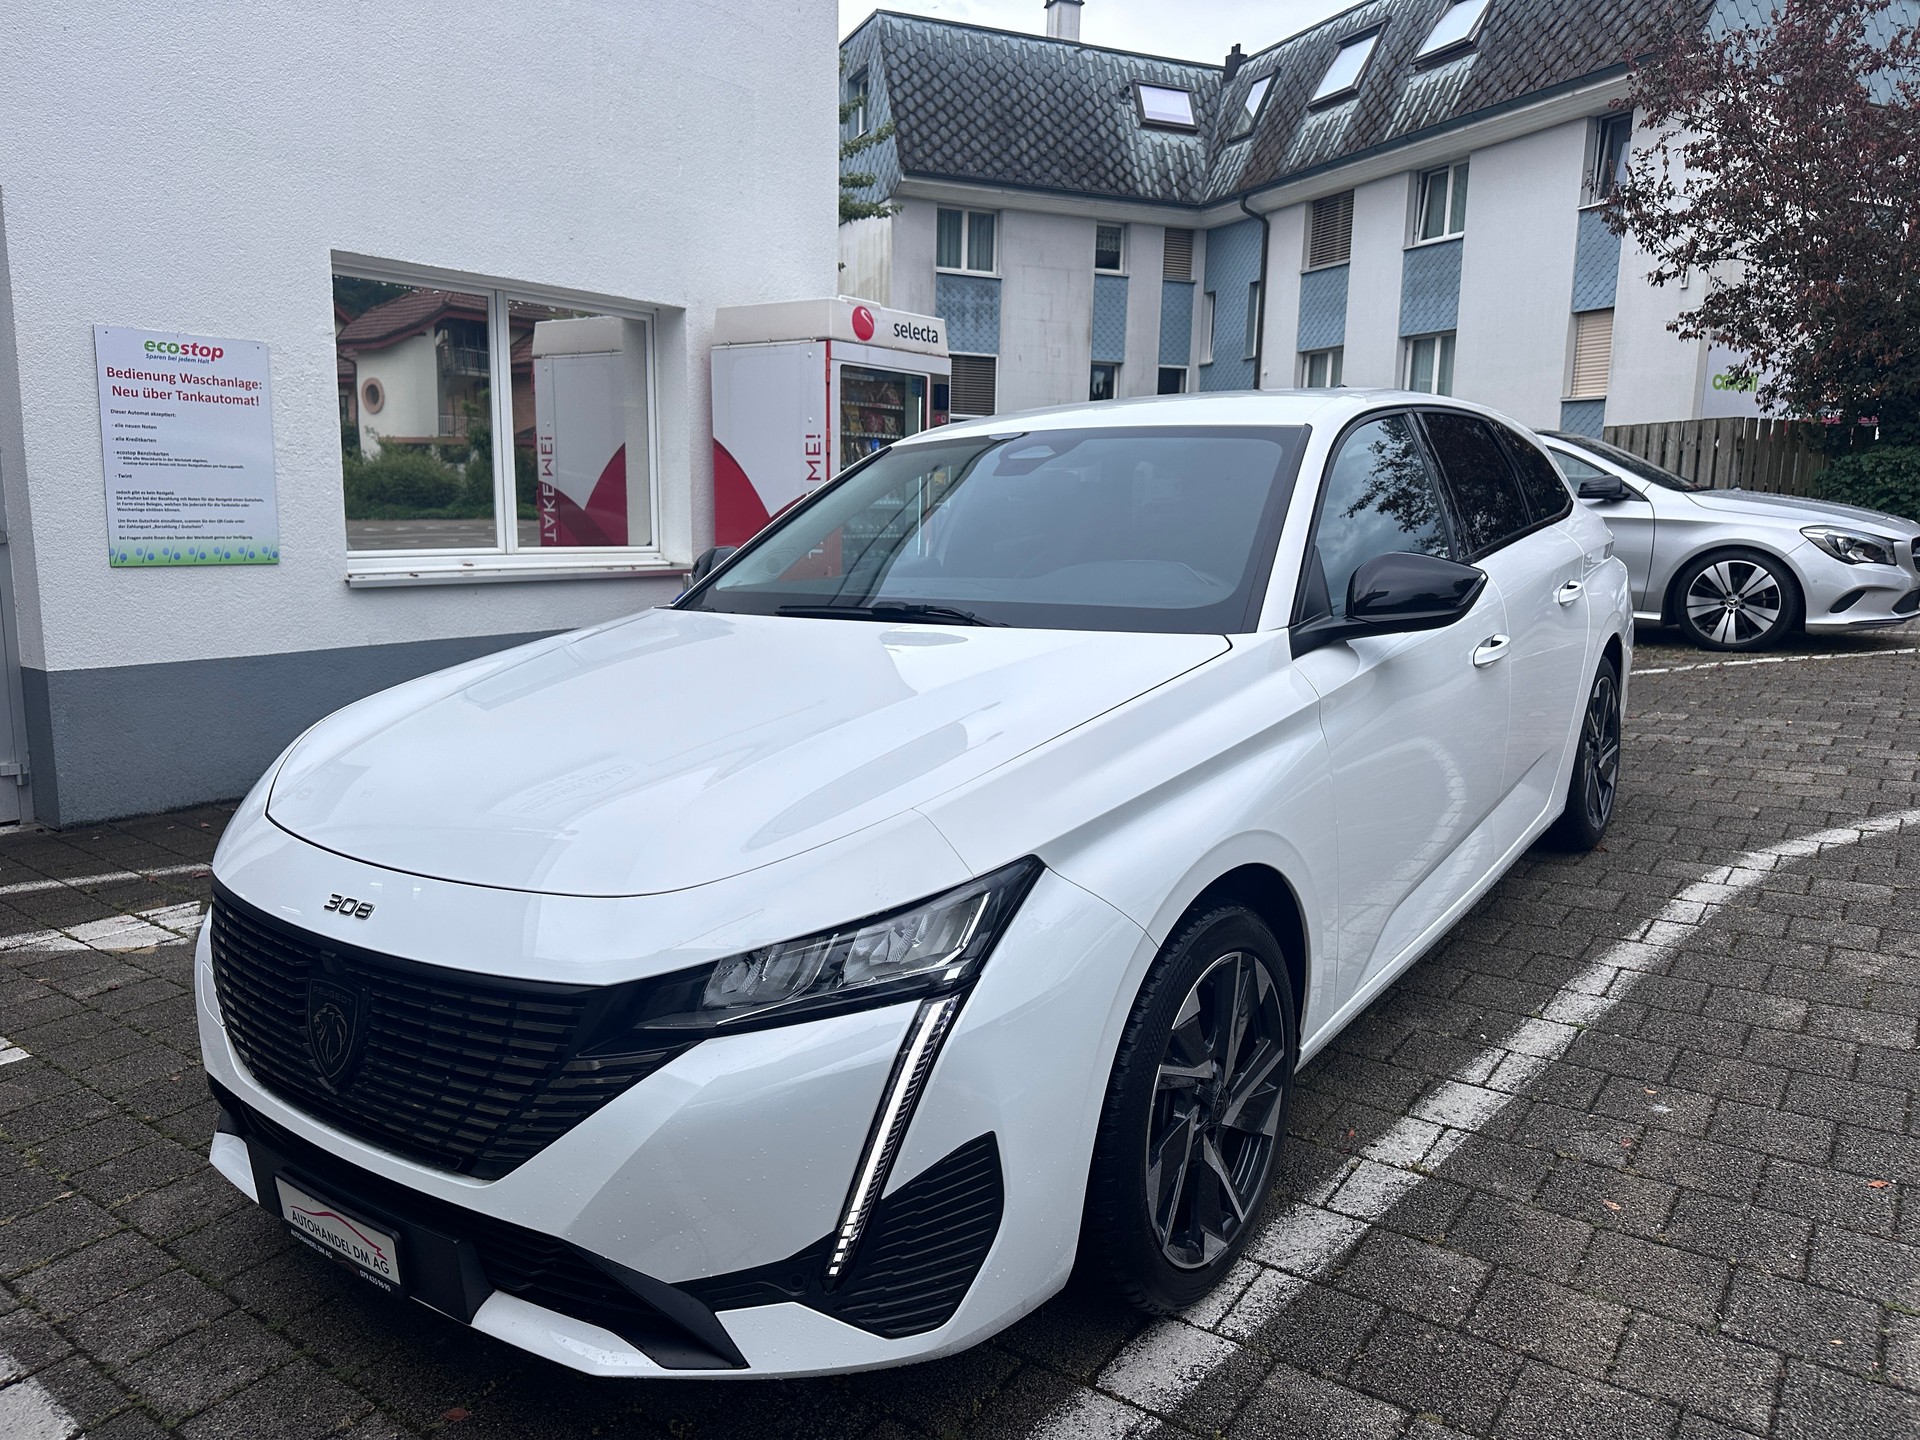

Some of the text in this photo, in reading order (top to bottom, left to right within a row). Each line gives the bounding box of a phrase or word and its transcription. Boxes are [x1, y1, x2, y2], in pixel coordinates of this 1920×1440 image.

[893, 322, 938, 344] selecta
[143, 339, 224, 362] ecostop
[145, 353, 166, 361] Sparen
[106, 367, 262, 391] Bedienung Waschanlage:
[112, 385, 260, 406] Neu über Tankautomat!
[805, 434, 822, 481] ME!
[323, 893, 376, 921] 308
[312, 985, 353, 1006] PEUGEOT
[291, 1210, 390, 1275] AUTOHANDEL DM AG
[325, 1250, 333, 1259] AG
